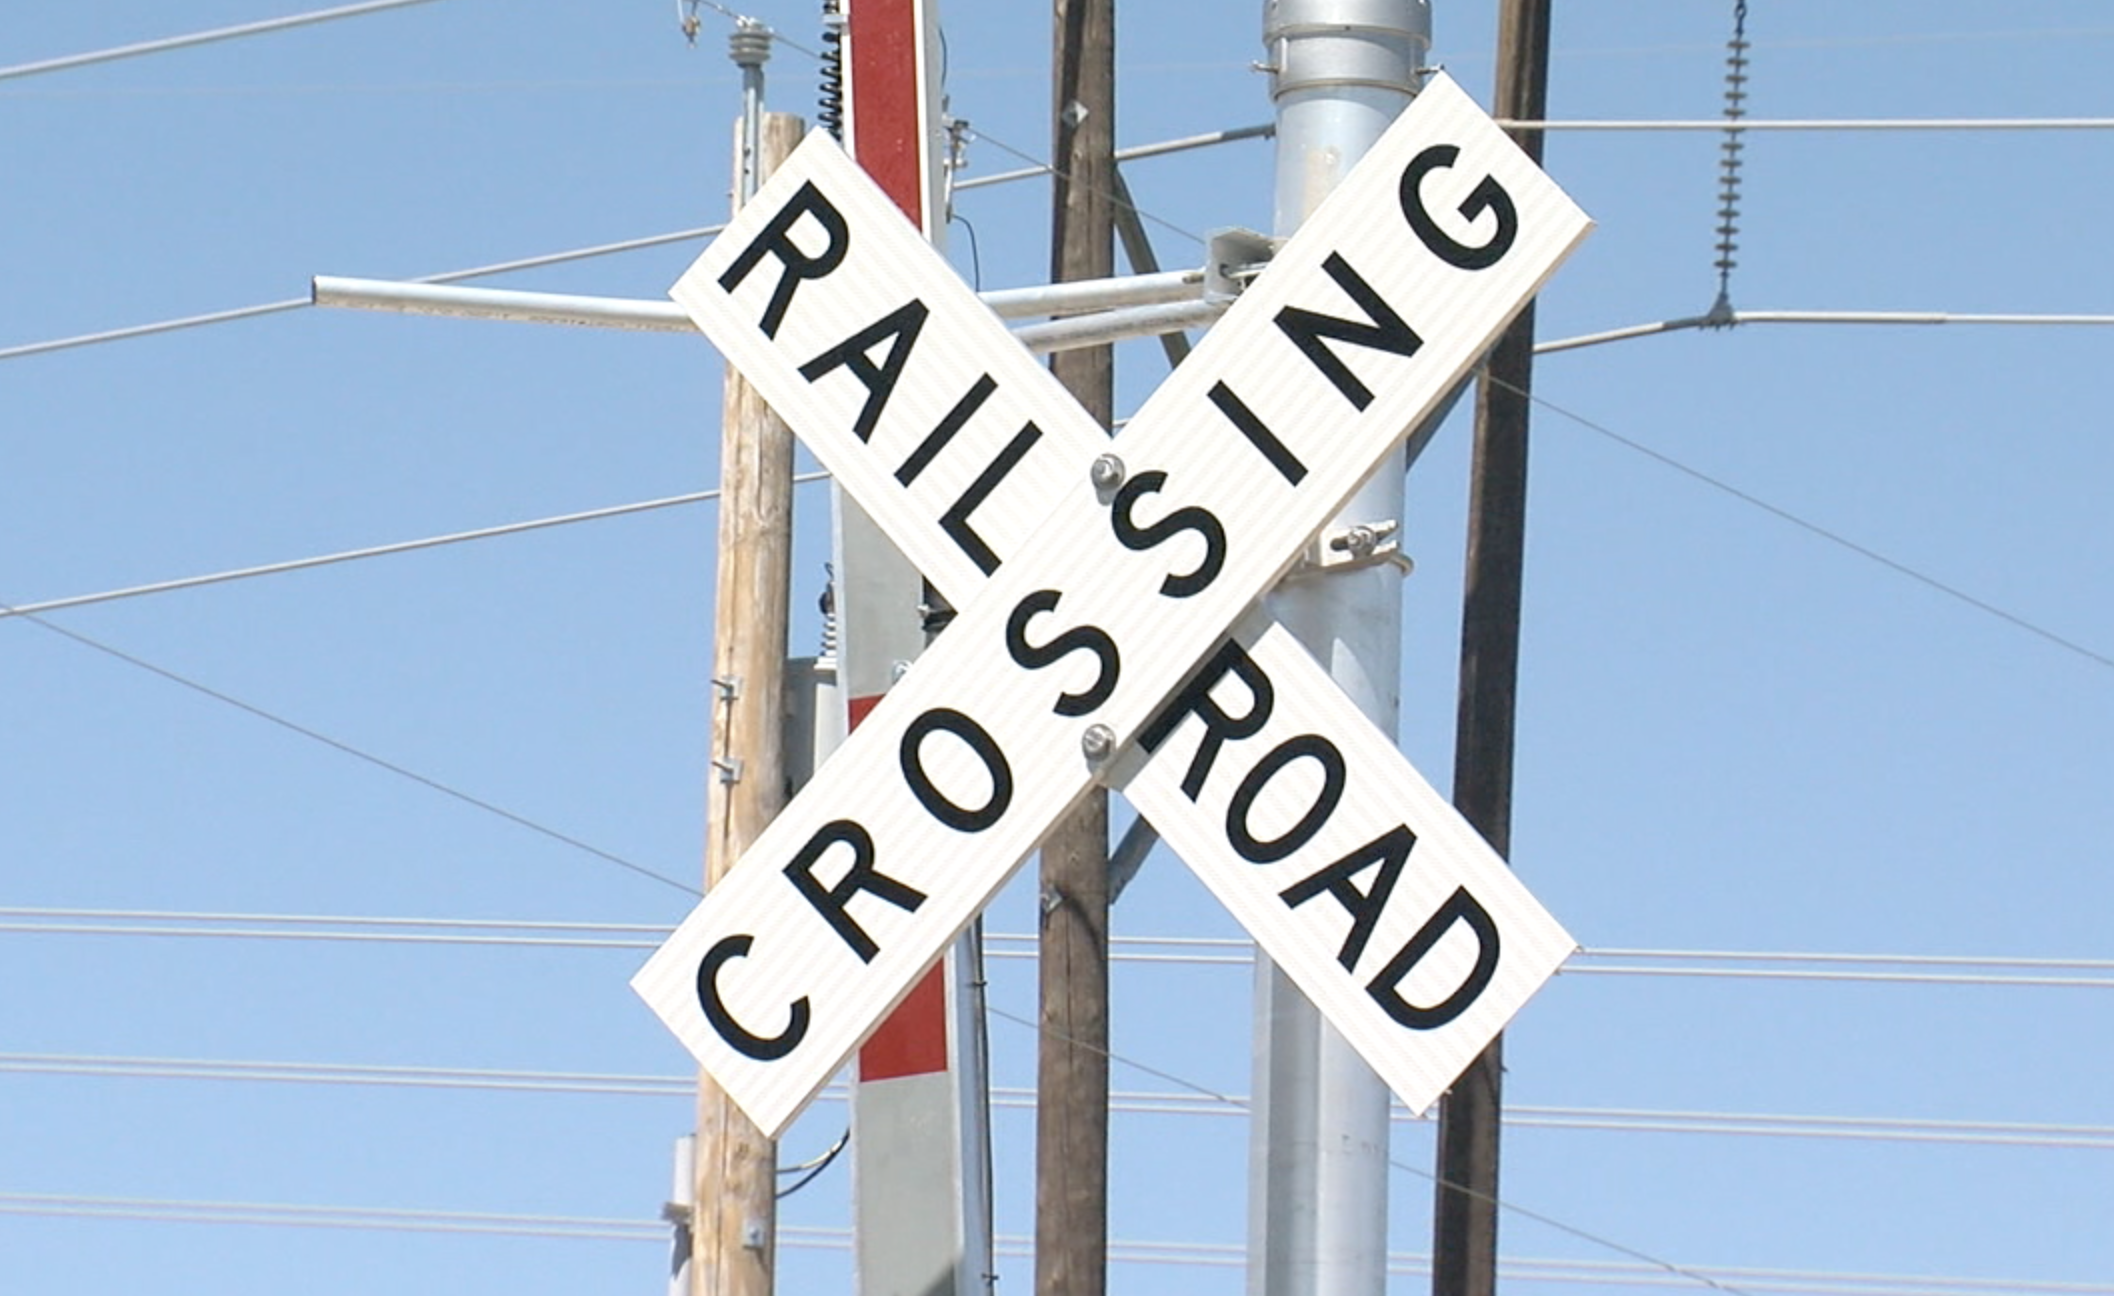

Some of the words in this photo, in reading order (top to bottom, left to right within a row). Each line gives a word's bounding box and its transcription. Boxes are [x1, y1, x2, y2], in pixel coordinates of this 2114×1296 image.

[697, 143, 1519, 1061] CROSSING
[718, 180, 1043, 577] RAIL
[1136, 637, 1500, 1031] ROAD
